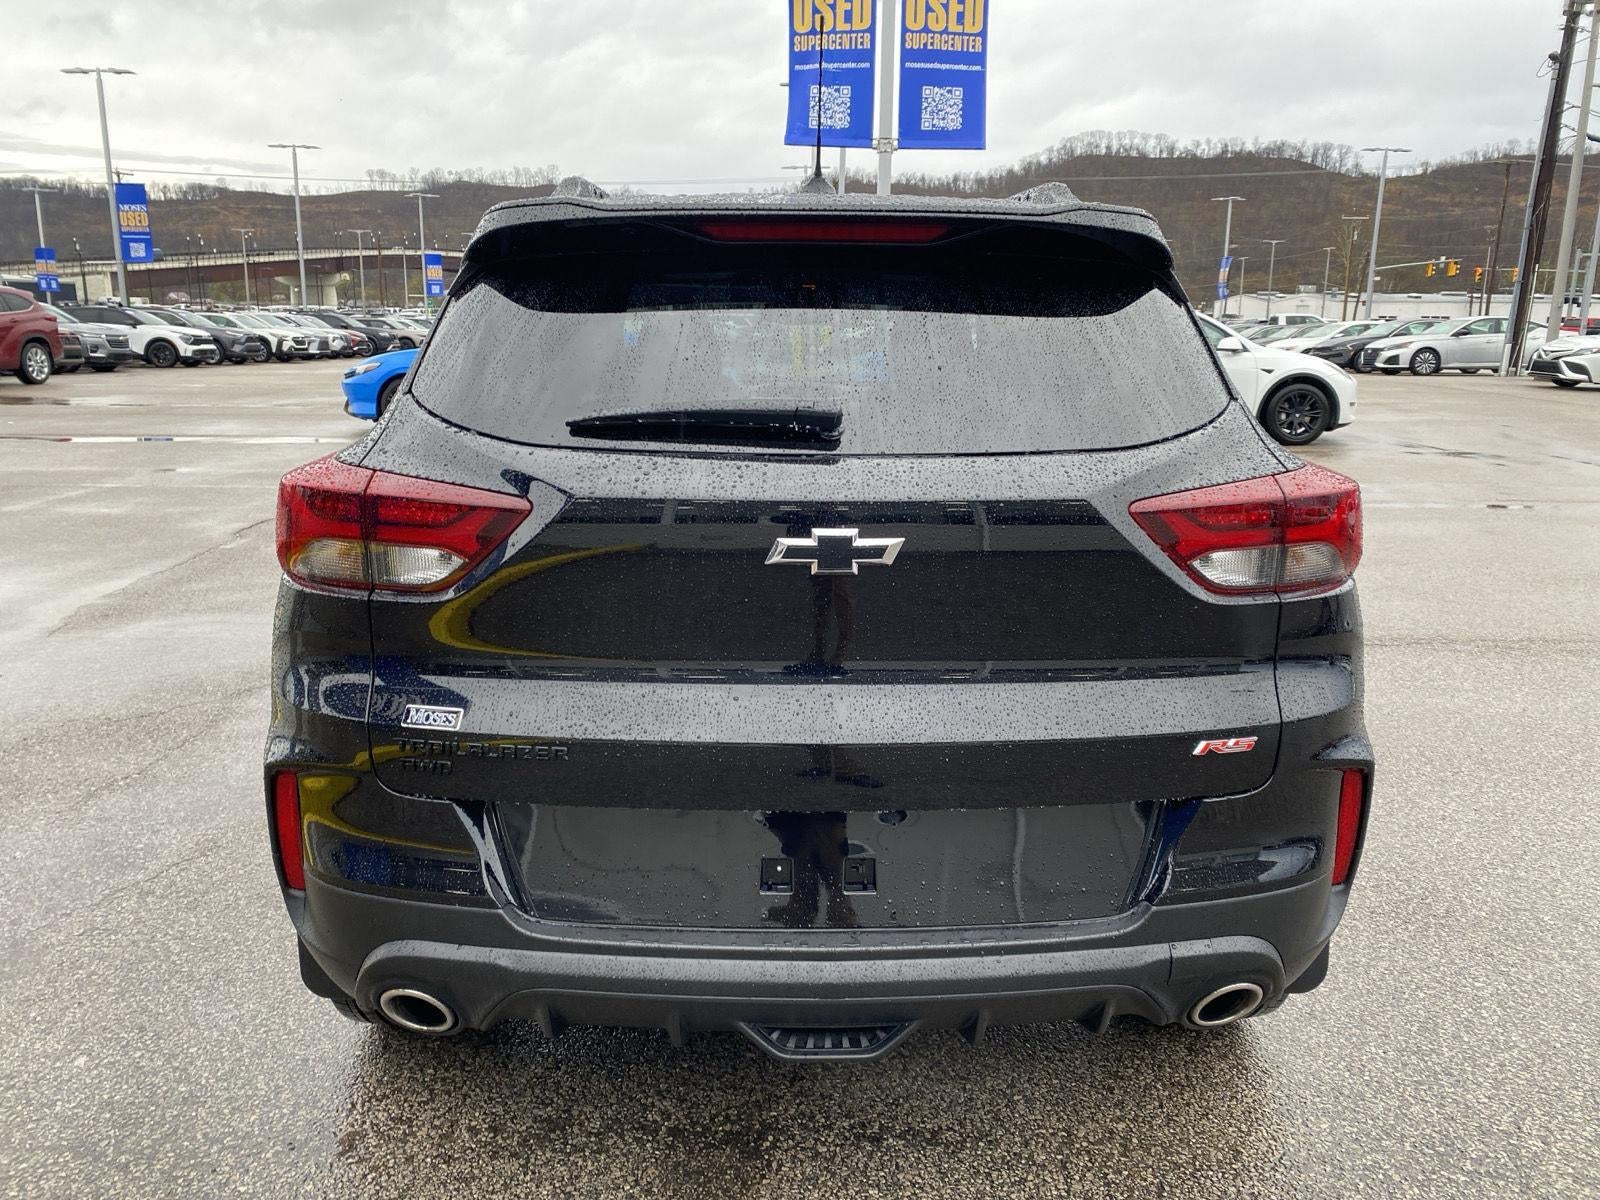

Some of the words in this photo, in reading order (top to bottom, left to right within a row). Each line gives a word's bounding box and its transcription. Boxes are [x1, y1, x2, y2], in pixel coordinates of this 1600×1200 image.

[793, 0, 872, 33] USED
[905, 0, 984, 33] USED
[793, 32, 871, 52] SUPERCENTER
[905, 32, 983, 53] SUPERCENTER
[794, 61, 871, 71] mosesusdsupercenter.com
[120, 211, 149, 227] USED
[406, 707, 457, 727] MOSES
[392, 736, 569, 761] TRAILBLAZER
[1192, 736, 1258, 756] RS
